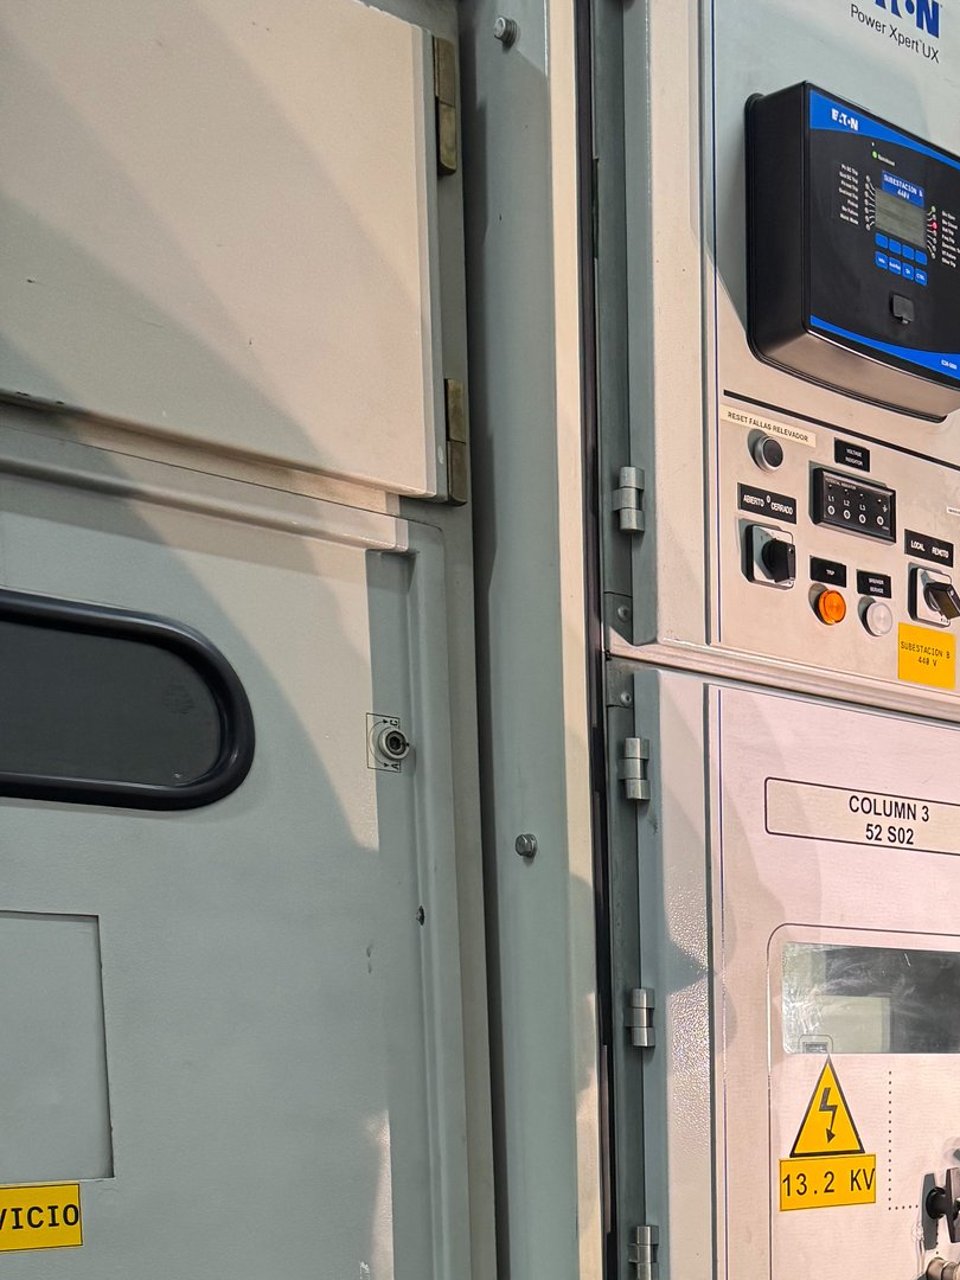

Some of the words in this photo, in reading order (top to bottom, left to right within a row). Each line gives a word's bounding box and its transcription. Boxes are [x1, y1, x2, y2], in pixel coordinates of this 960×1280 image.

[850, 4, 886, 34] Power
[889, 24, 919, 53] Xpert
[922, 43, 940, 63] UX
[831, 108, 859, 131] EATON
[728, 411, 748, 424] RESET
[749, 417, 772, 431] FALLAS
[772, 424, 809, 443] RELEVADOR
[743, 494, 764, 507] ABIERTO
[771, 502, 794, 516] CERRADO
[910, 540, 925, 552] LOCAL
[901, 641, 943, 659] SUBESTACION
[946, 651, 950, 659] B
[932, 659, 937, 667] V
[849, 795, 917, 821] COLUMN
[921, 805, 930, 822] 3
[865, 823, 882, 841] 52
[887, 825, 914, 845] S02
[782, 1171, 835, 1197] 13.2
[850, 1168, 875, 1192] KV
